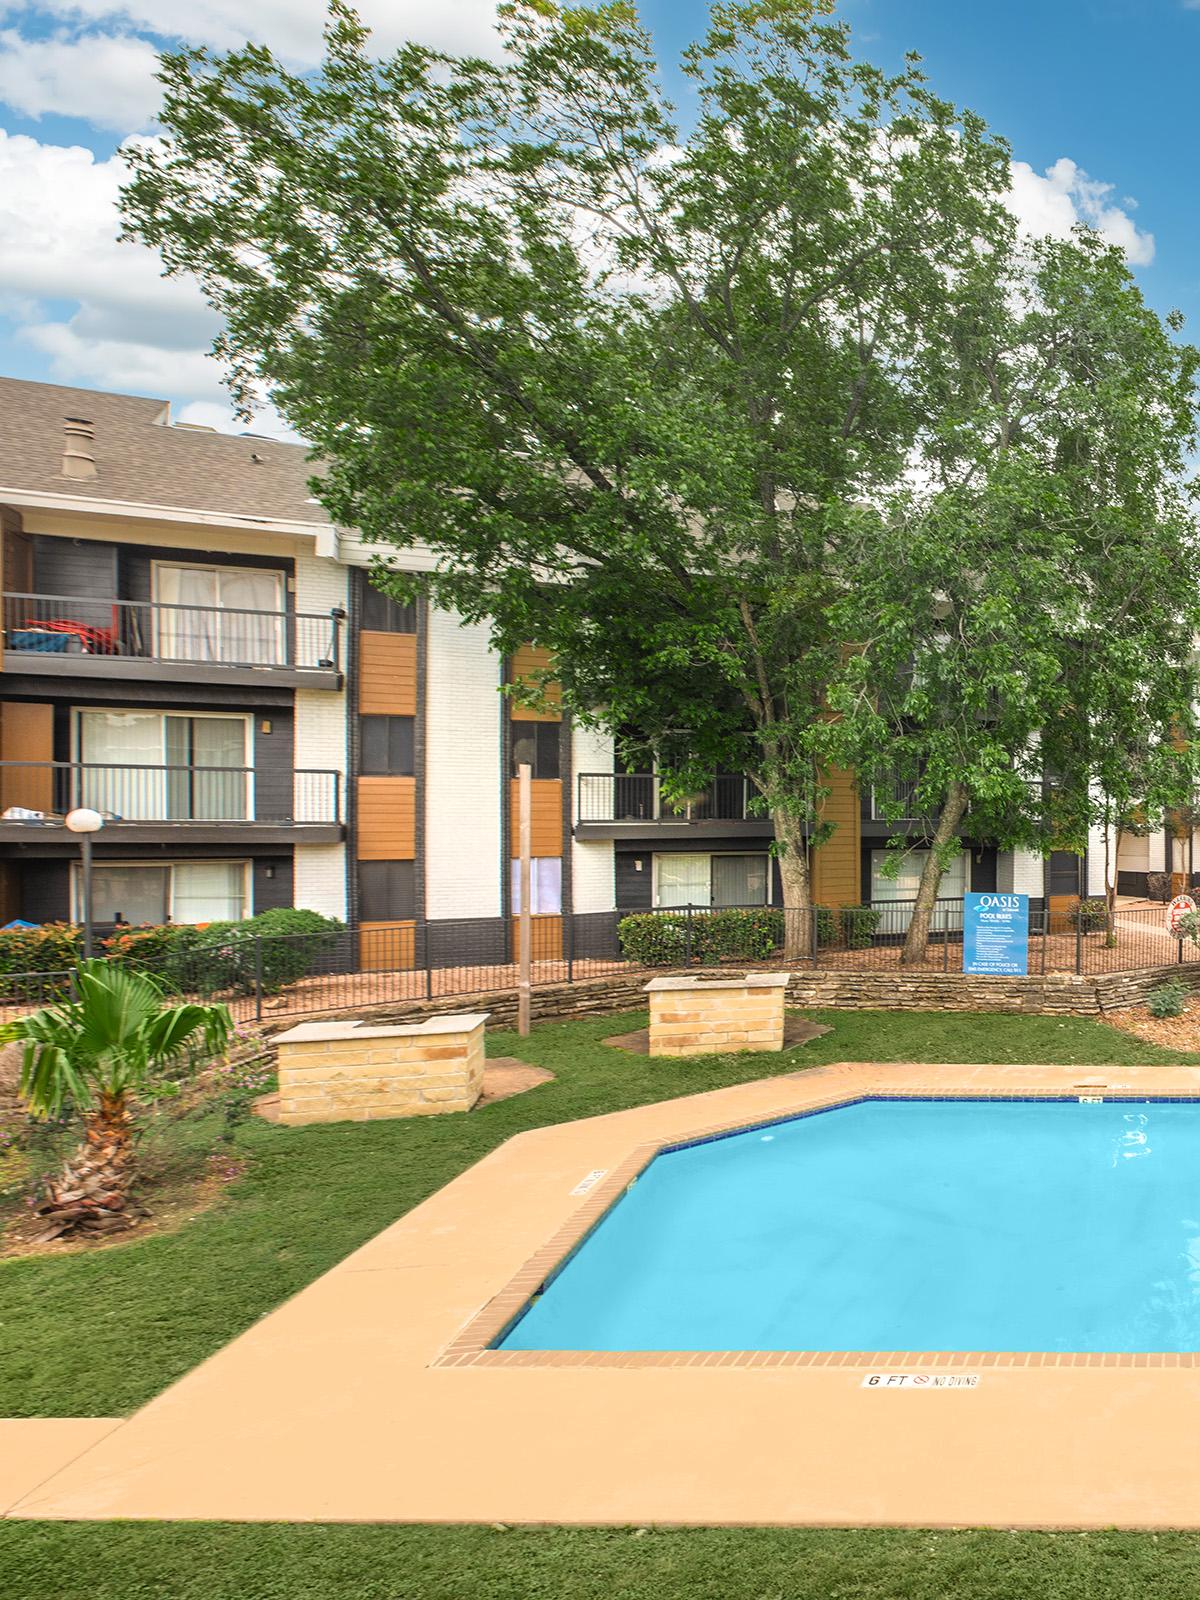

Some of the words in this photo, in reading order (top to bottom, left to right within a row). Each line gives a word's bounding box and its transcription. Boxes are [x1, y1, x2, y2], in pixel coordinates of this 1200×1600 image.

[980, 896, 1020, 908] OASIS
[868, 1376, 881, 1386] 6
[887, 1376, 908, 1386] FT
[933, 1376, 946, 1387] NO
[948, 1376, 977, 1387] DIVING
